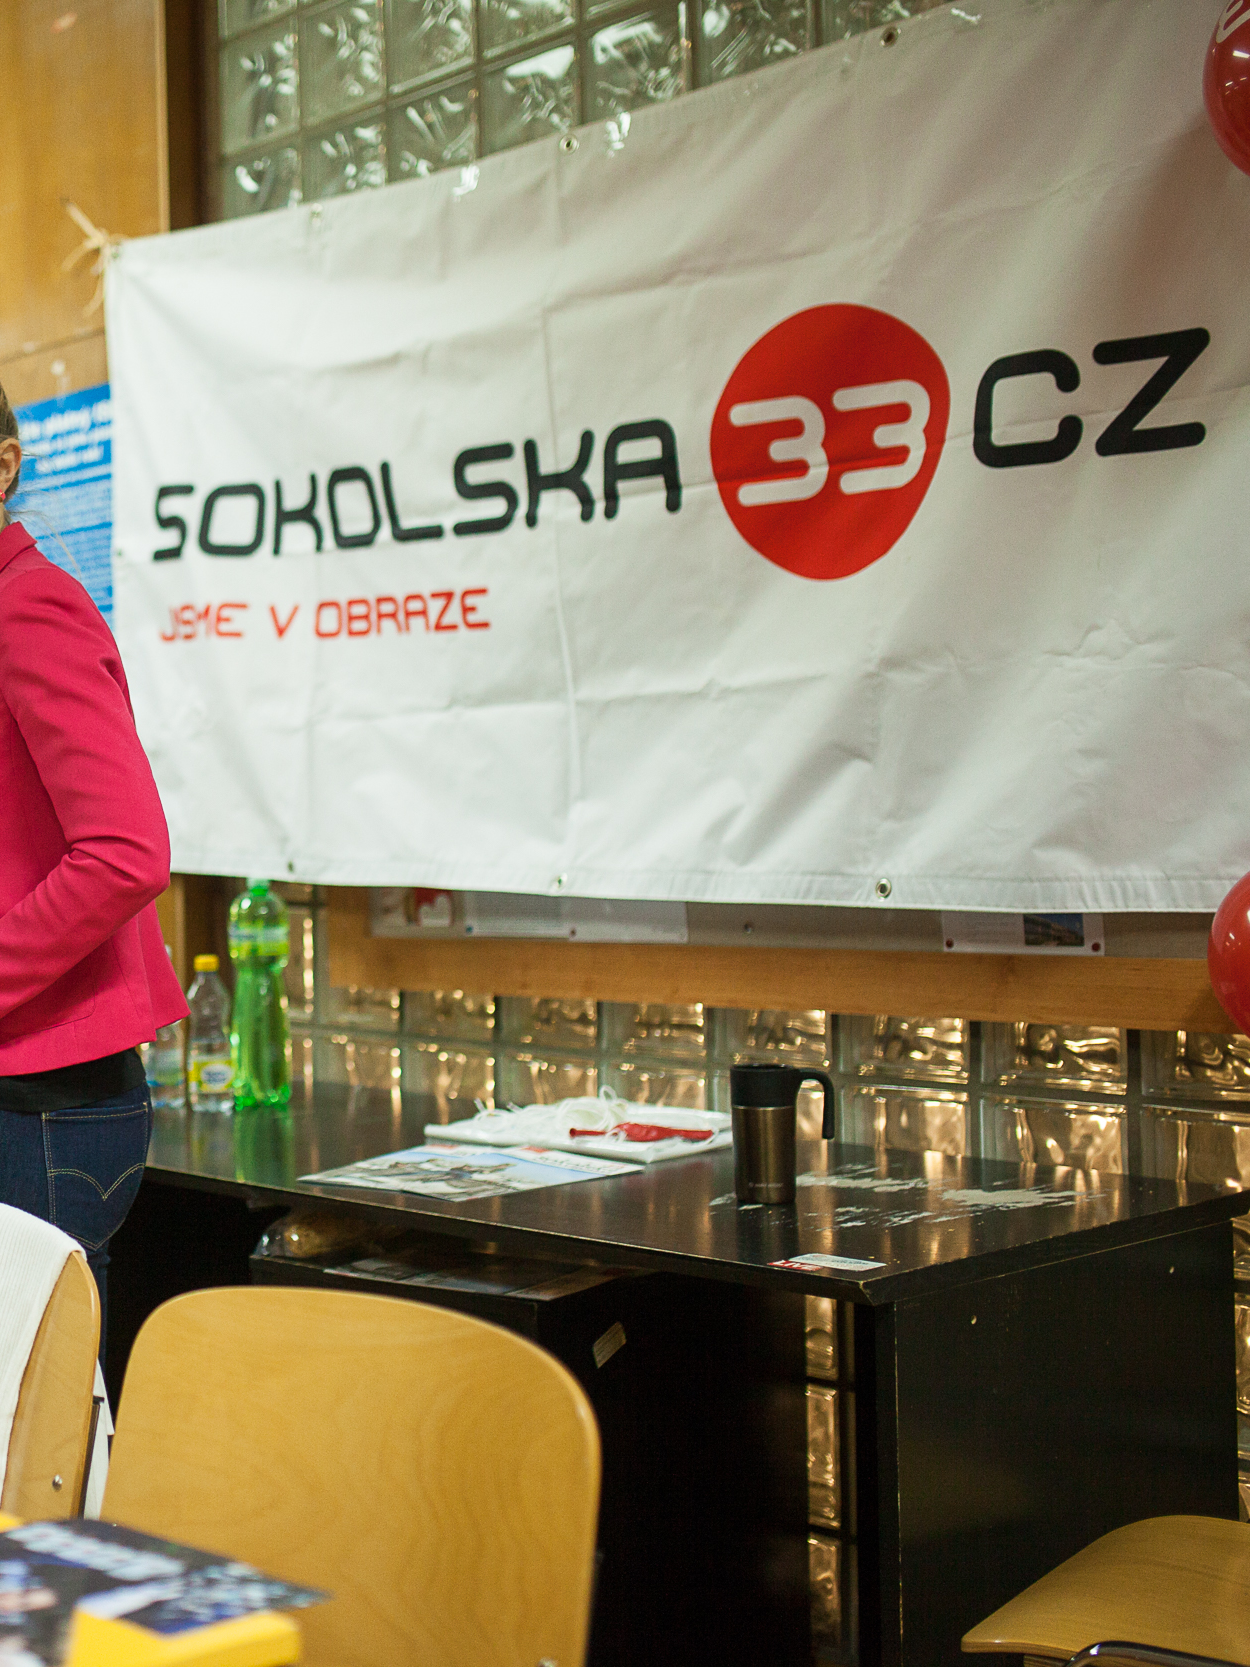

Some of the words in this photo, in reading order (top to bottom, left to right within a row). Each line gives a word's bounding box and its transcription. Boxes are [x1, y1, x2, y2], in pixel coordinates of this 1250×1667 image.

[153, 419, 682, 561] SOKOLSKA
[730, 379, 931, 505] 33
[973, 327, 1211, 469] CZ
[160, 603, 248, 645] JSME
[271, 603, 299, 640] V
[315, 588, 492, 640] OBRAZE
